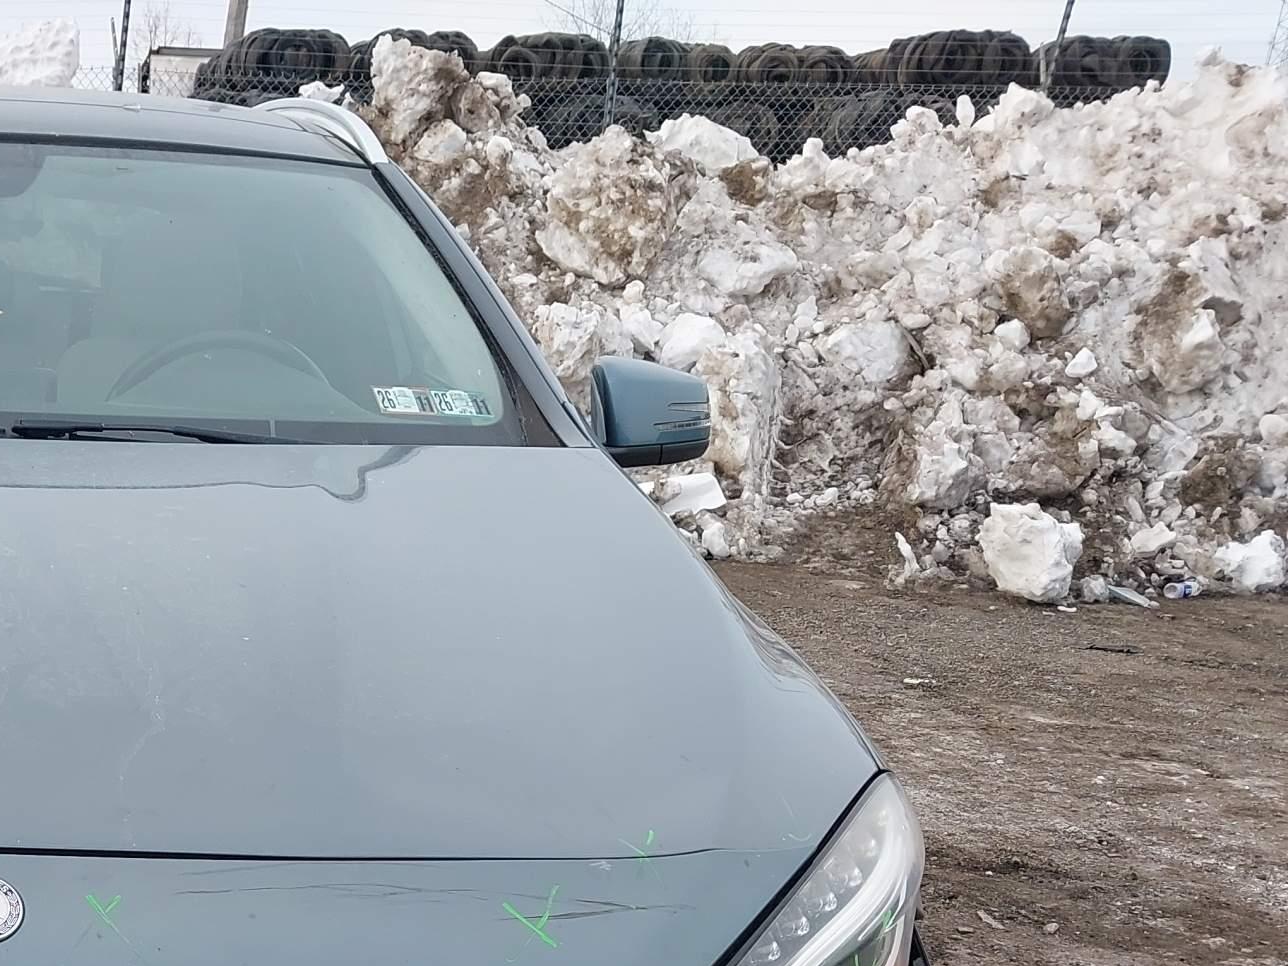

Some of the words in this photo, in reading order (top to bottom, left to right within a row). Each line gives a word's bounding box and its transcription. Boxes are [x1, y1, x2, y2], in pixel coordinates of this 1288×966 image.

[377, 390, 396, 409] 26
[416, 395, 434, 413] 11
[434, 393, 453, 411] 26
[472, 398, 491, 415] 11
